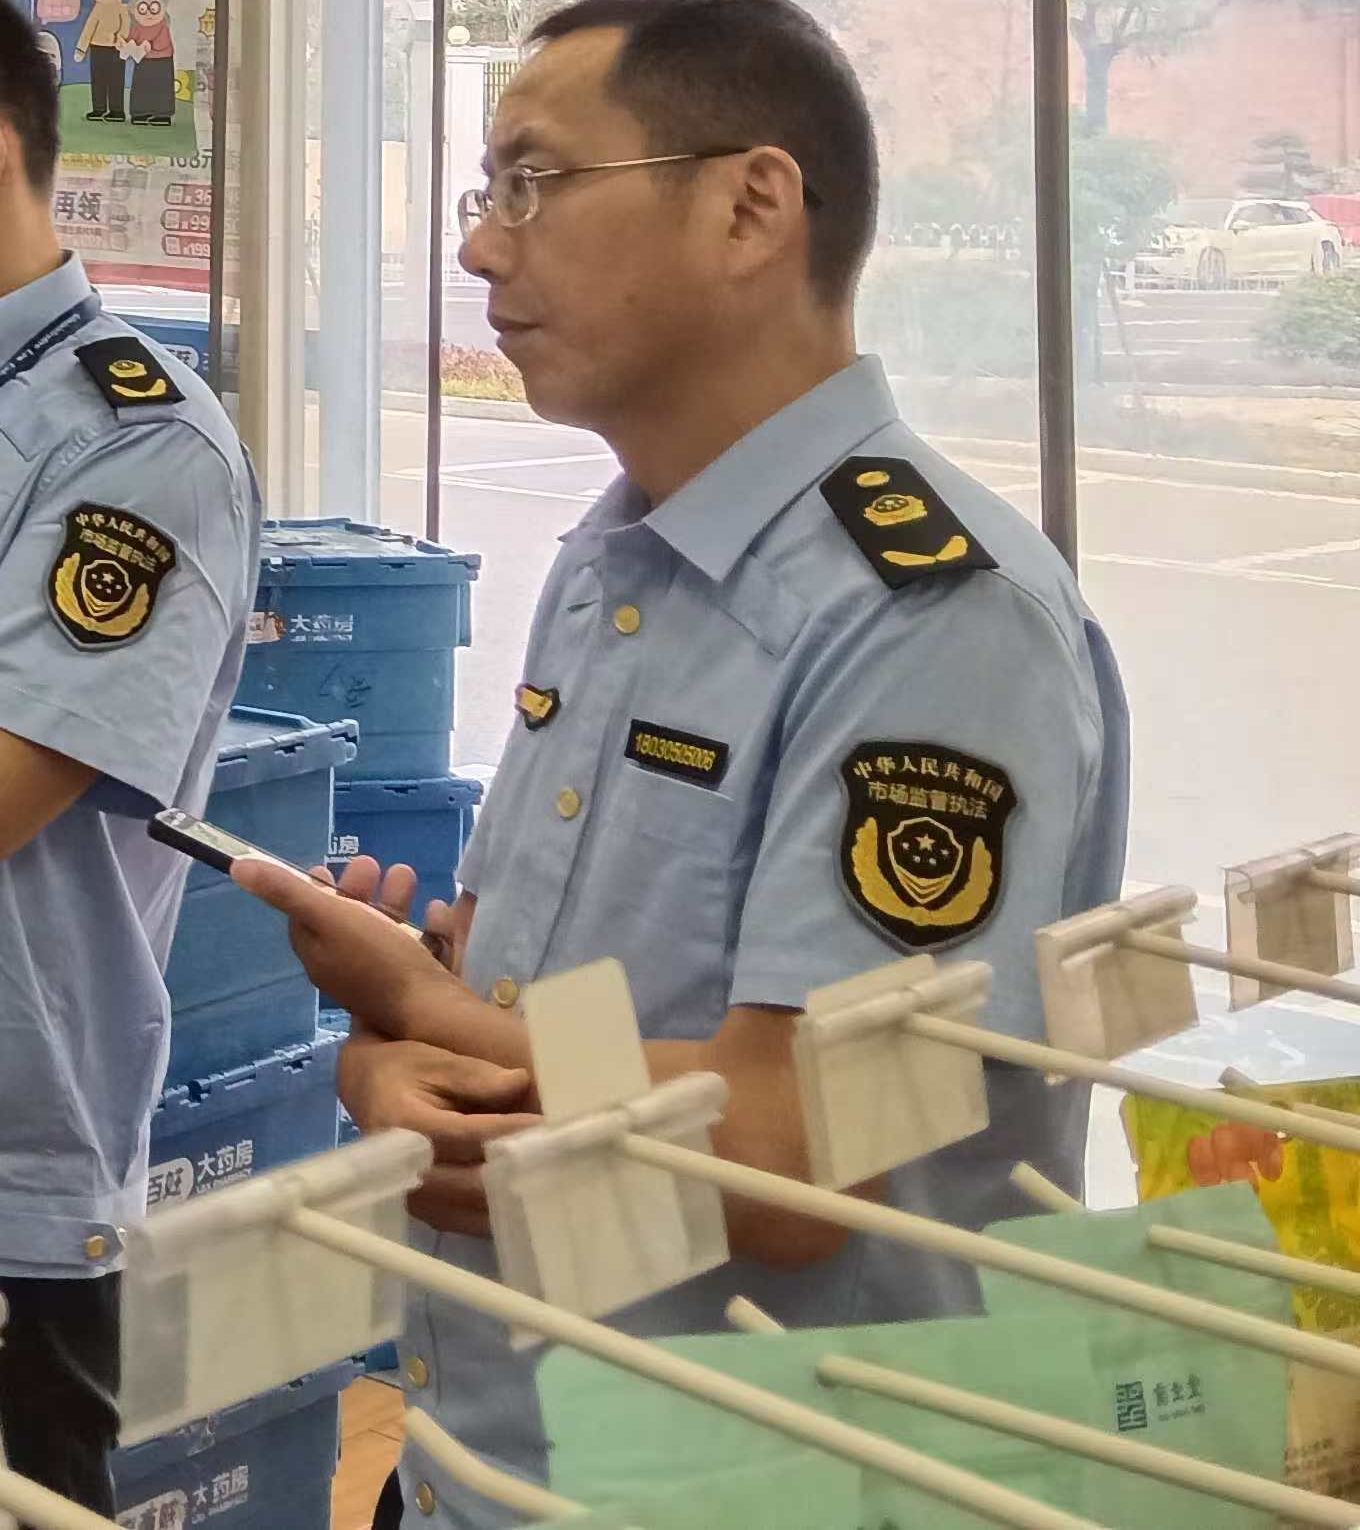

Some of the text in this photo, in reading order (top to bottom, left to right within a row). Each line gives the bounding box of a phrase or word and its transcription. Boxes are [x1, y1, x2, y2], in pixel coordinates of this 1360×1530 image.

[853, 754, 1005, 804] 中华人民共和国
[196, 1139, 255, 1182] 大药房
[193, 1465, 249, 1507] 大药房
